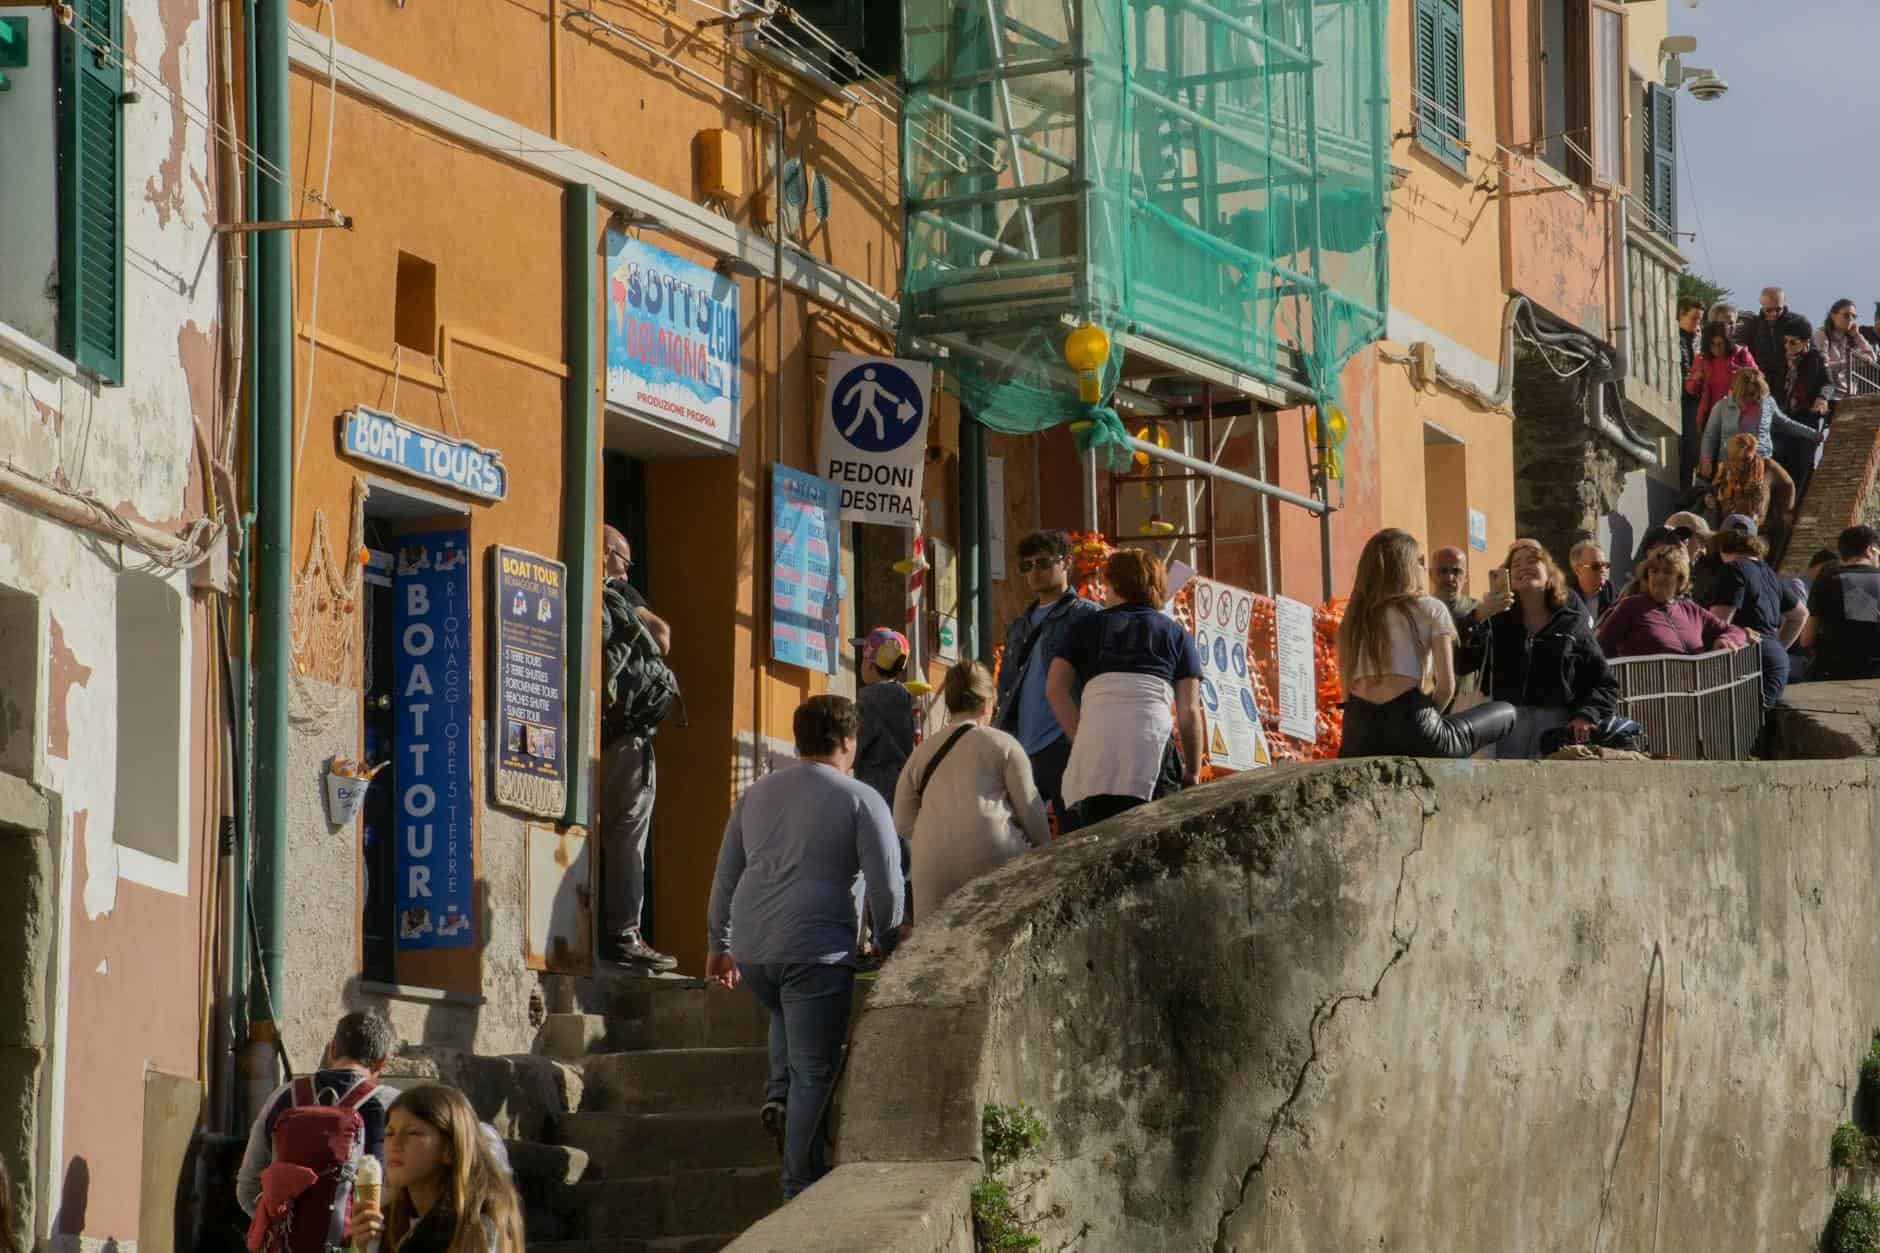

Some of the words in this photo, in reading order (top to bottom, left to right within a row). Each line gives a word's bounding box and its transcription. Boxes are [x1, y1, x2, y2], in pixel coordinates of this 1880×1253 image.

[627, 263, 709, 335] SOTTO
[637, 391, 685, 417] PRODUZIONE
[355, 413, 411, 464] BOAT
[420, 439, 499, 494] TOURS
[828, 460, 914, 488] PEDONI
[840, 489, 914, 515] DESTRA
[502, 557, 531, 578] BOAT
[533, 565, 559, 587] TOUR
[402, 583, 435, 737] BOAT
[443, 581, 460, 775] RIOMAGGIORE
[403, 743, 436, 899] TOUR
[448, 786, 457, 799] 5
[448, 805, 457, 894] TERRE
